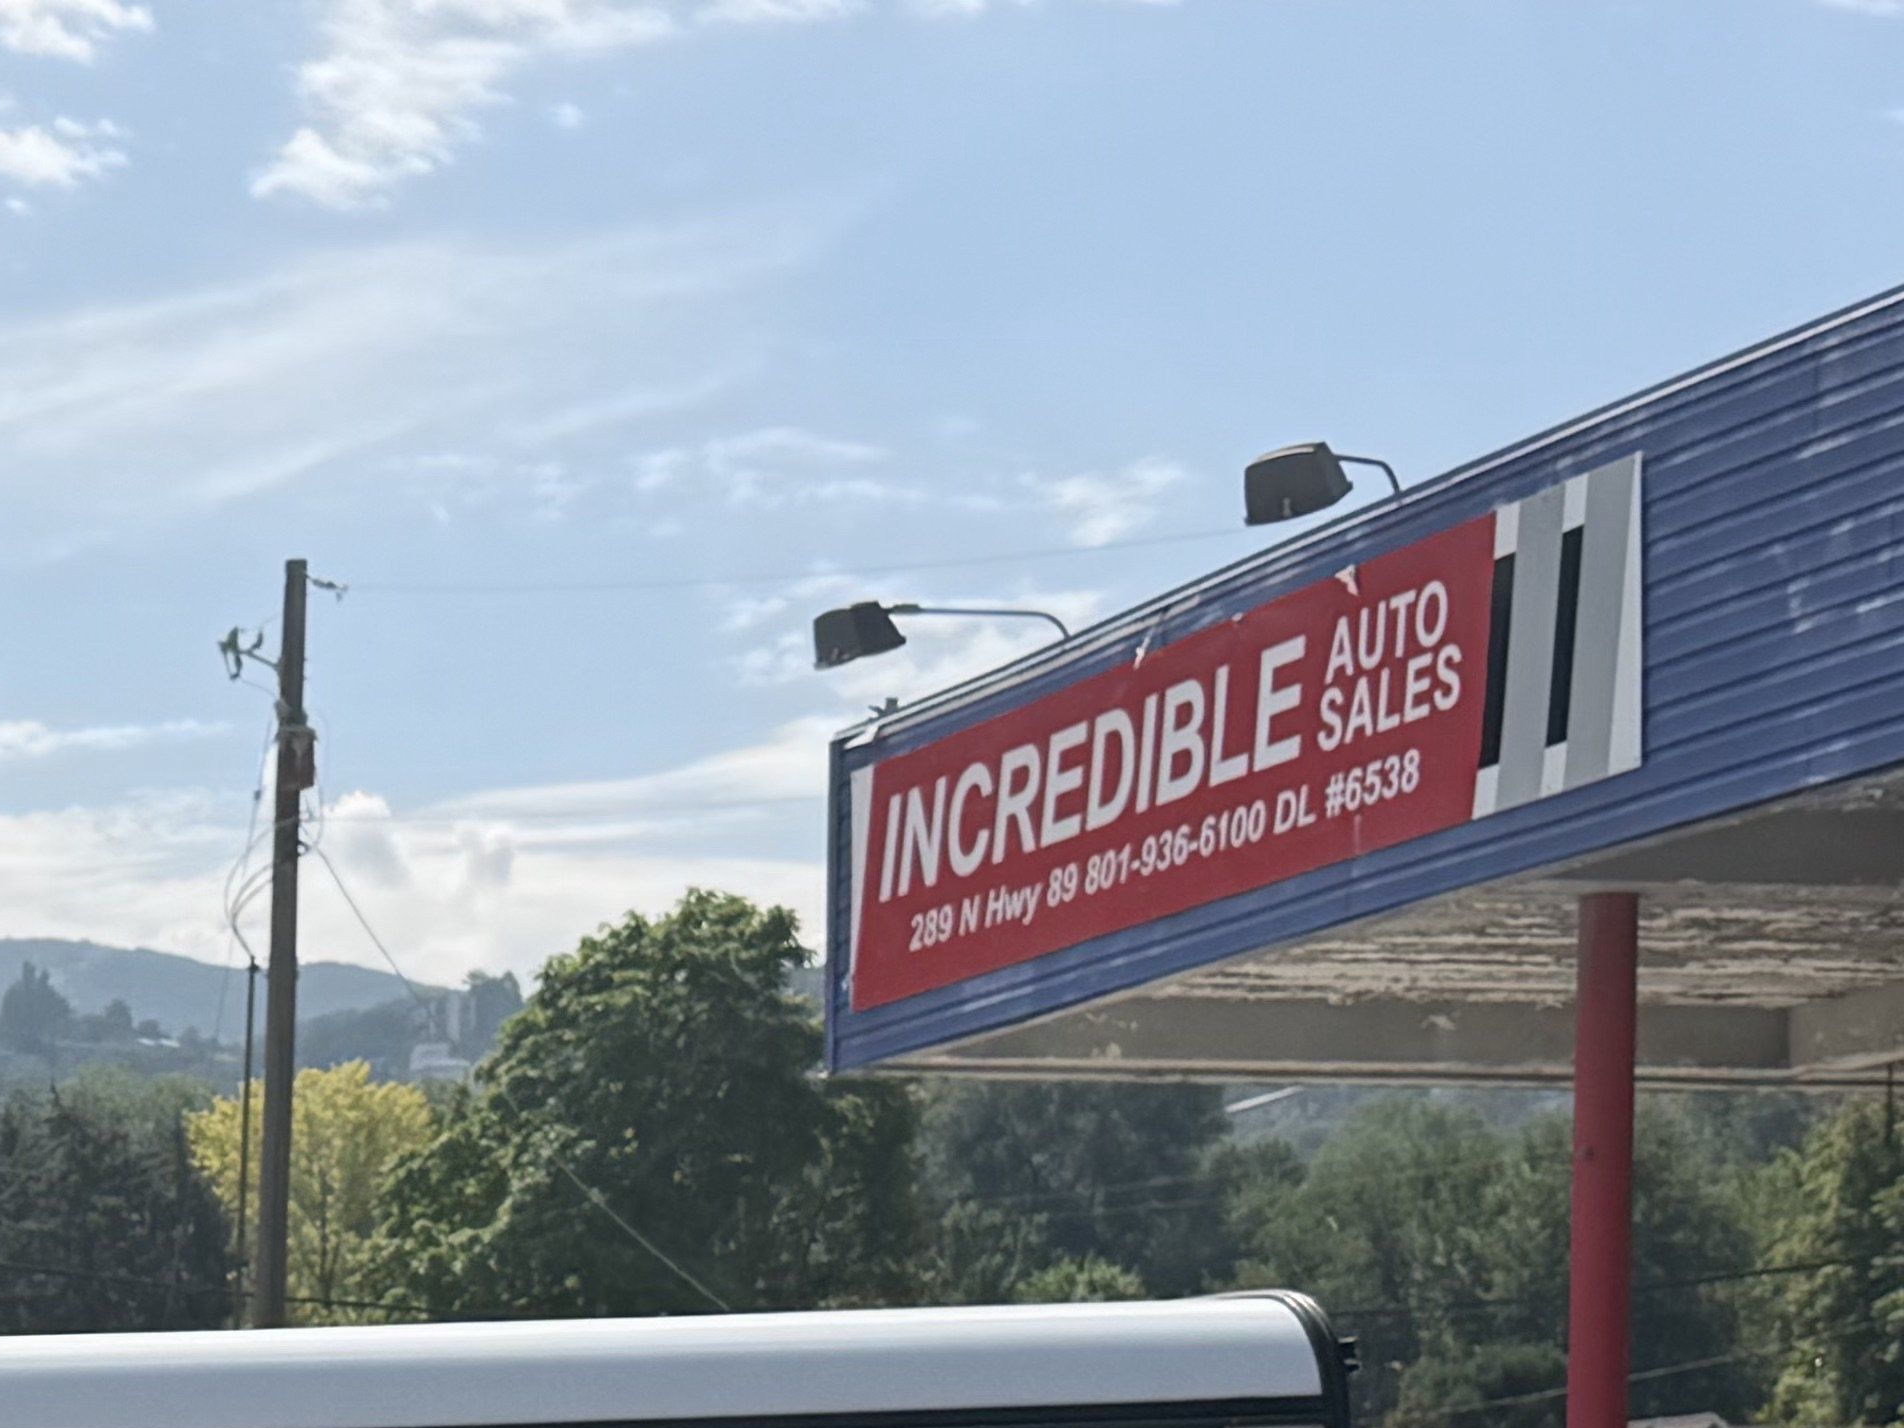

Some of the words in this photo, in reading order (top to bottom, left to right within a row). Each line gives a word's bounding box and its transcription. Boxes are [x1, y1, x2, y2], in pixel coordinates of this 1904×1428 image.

[1317, 643, 1462, 752] SALES
[1324, 579, 1448, 685] AUTO
[878, 634, 1307, 903] INCREDIBLE
[908, 904, 953, 952] 289
[958, 894, 981, 937] N
[984, 882, 1044, 926] Hwy
[1046, 862, 1079, 908] 89
[1084, 799, 1267, 896] 801-936-6100
[1272, 784, 1317, 835] DL
[1324, 749, 1421, 818] #6538
